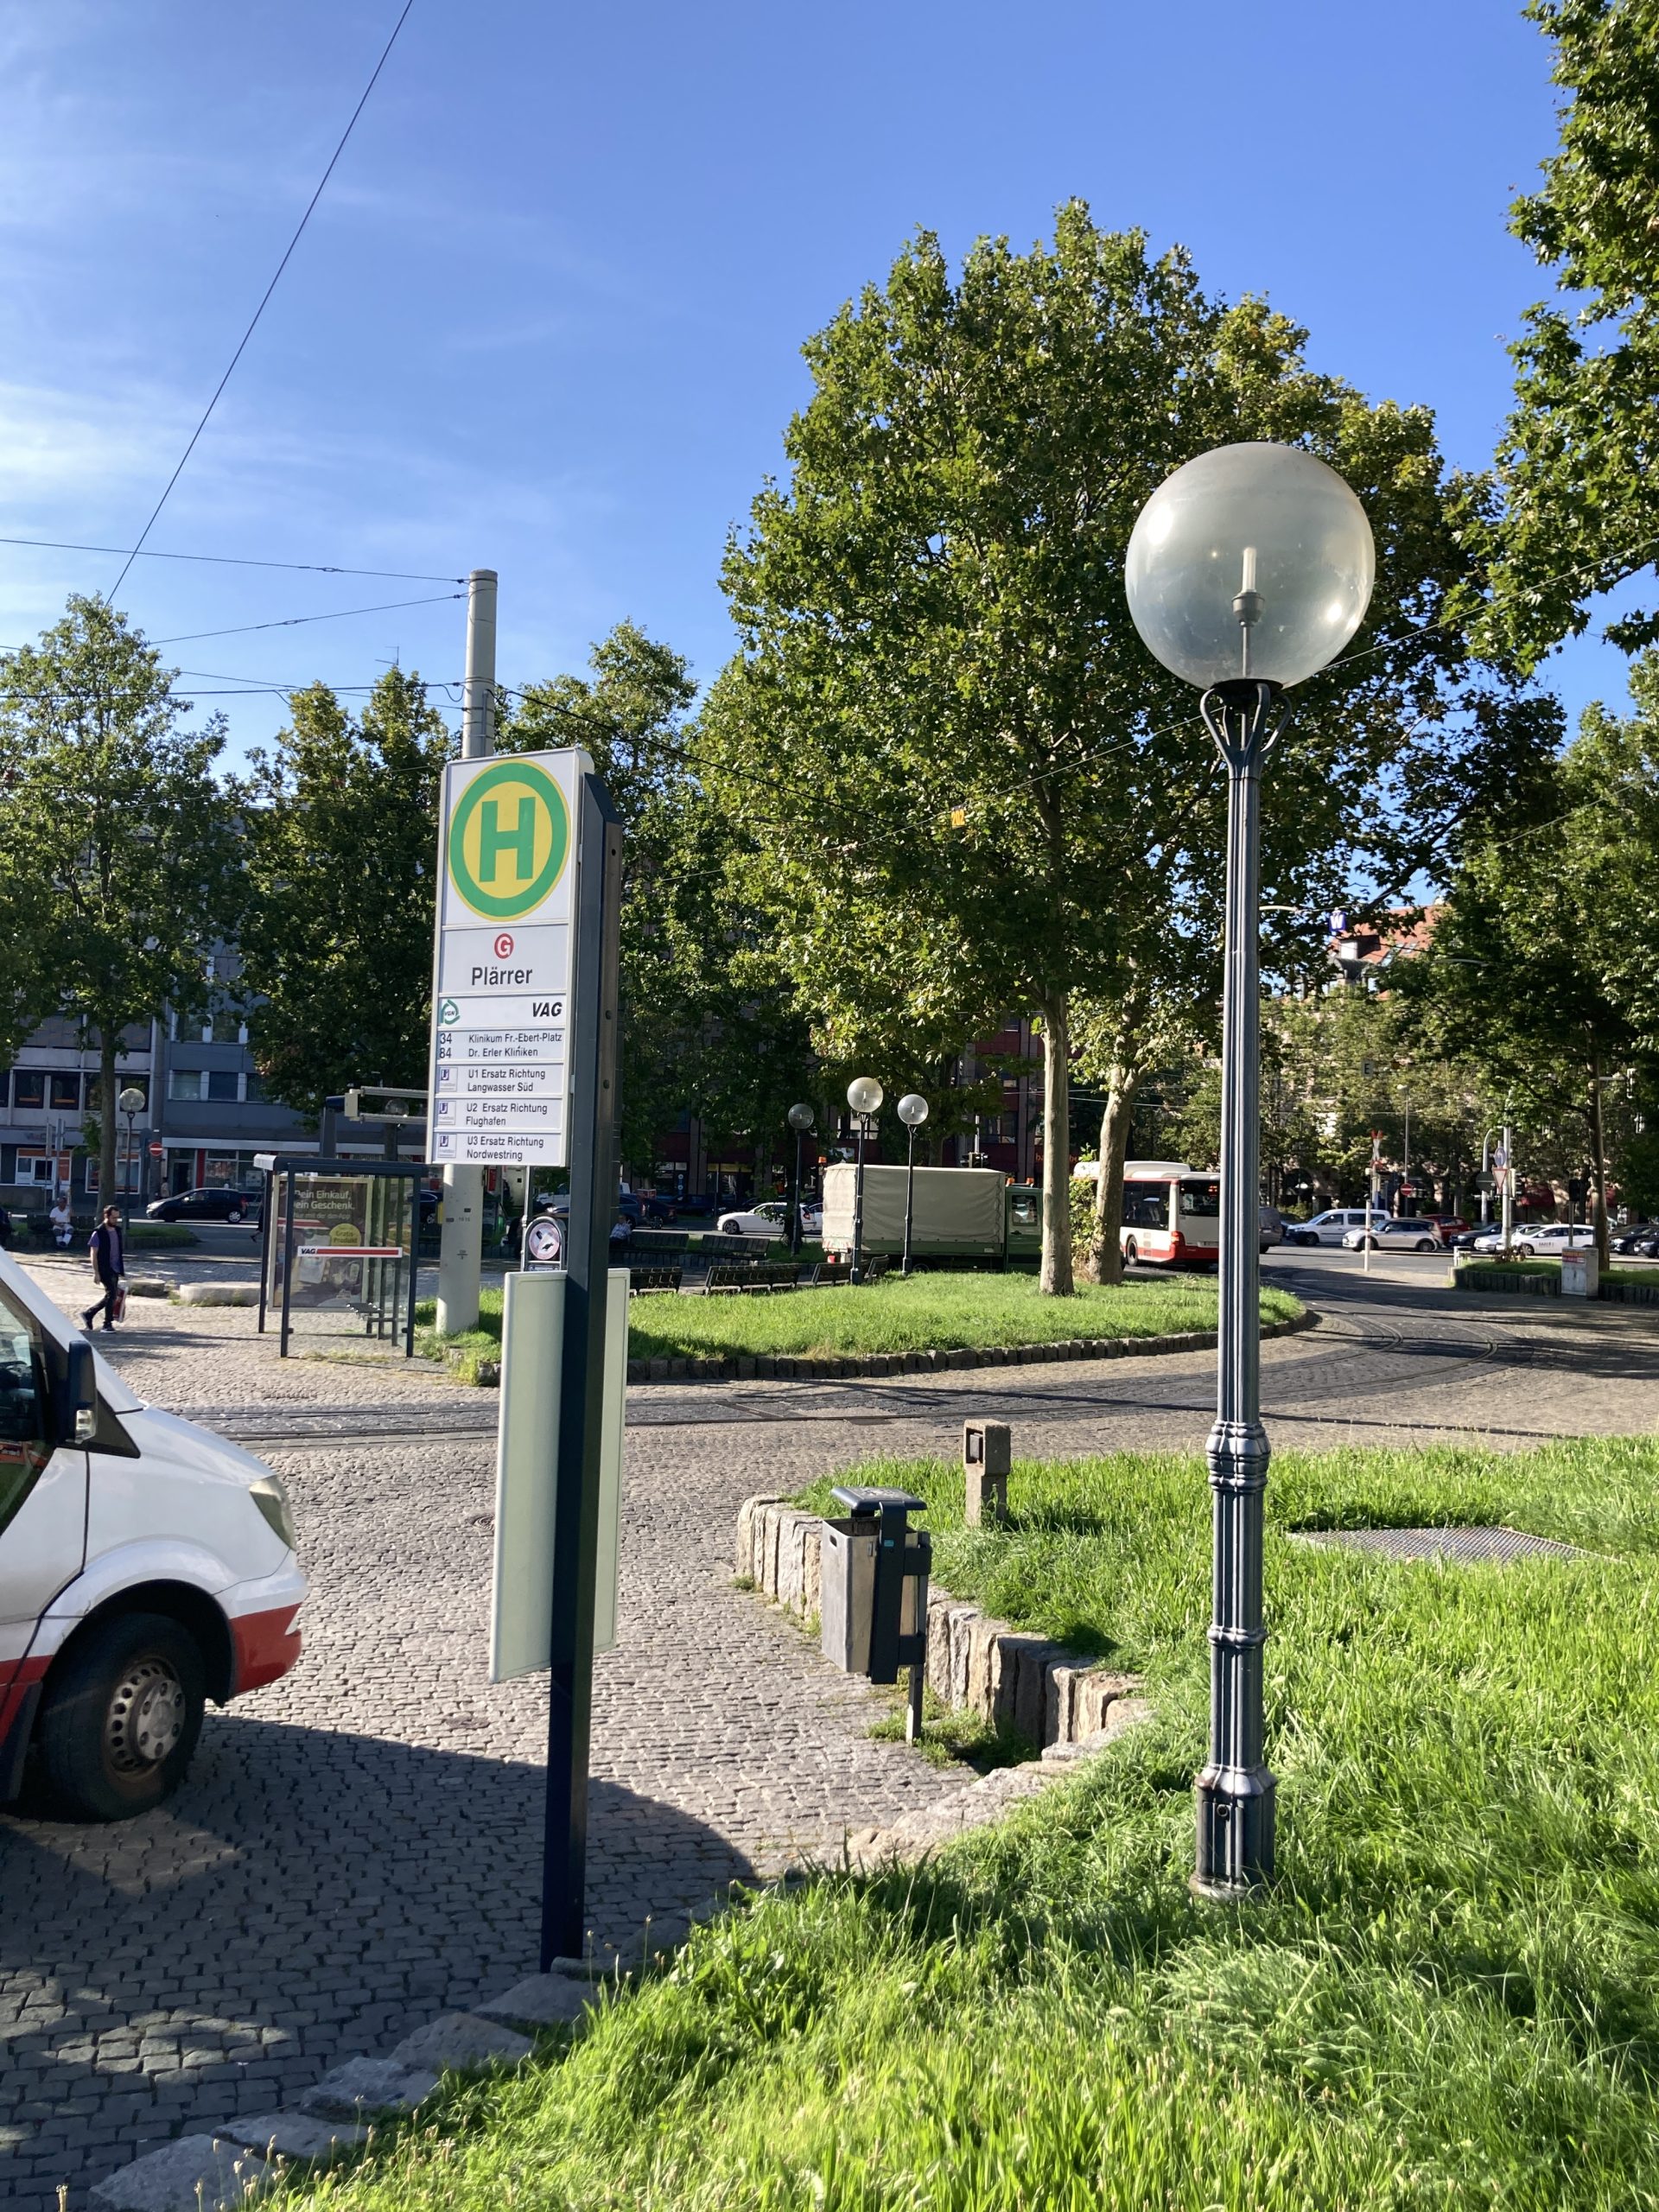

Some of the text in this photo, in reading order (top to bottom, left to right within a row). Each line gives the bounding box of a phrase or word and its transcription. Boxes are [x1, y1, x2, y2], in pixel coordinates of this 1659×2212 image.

[479, 796, 536, 882] H
[1330, 916, 1344, 930] W
[496, 936, 512, 957] G
[472, 966, 532, 985] Plärrer
[532, 1001, 563, 1017] VAG
[440, 1033, 562, 1045] 34 Klinikum Fr.-Ebert-Platz
[439, 1047, 538, 1058] 84 Dr. Erler Kliniken
[468, 1069, 545, 1080] U1 Ersatz Richtung
[1364, 1063, 1370, 1075] E
[467, 1082, 515, 1093] Langwasser
[517, 1082, 533, 1092] Süd
[467, 1103, 547, 1115] U2 Ersatz Richtung
[466, 1116, 506, 1128] Flughafen
[467, 1135, 543, 1148] U3 Ersatz Richtung
[467, 1149, 523, 1161] Nordwestring
[316, 1190, 351, 1200] Einkauf,
[311, 1200, 355, 1210] Geschenk.
